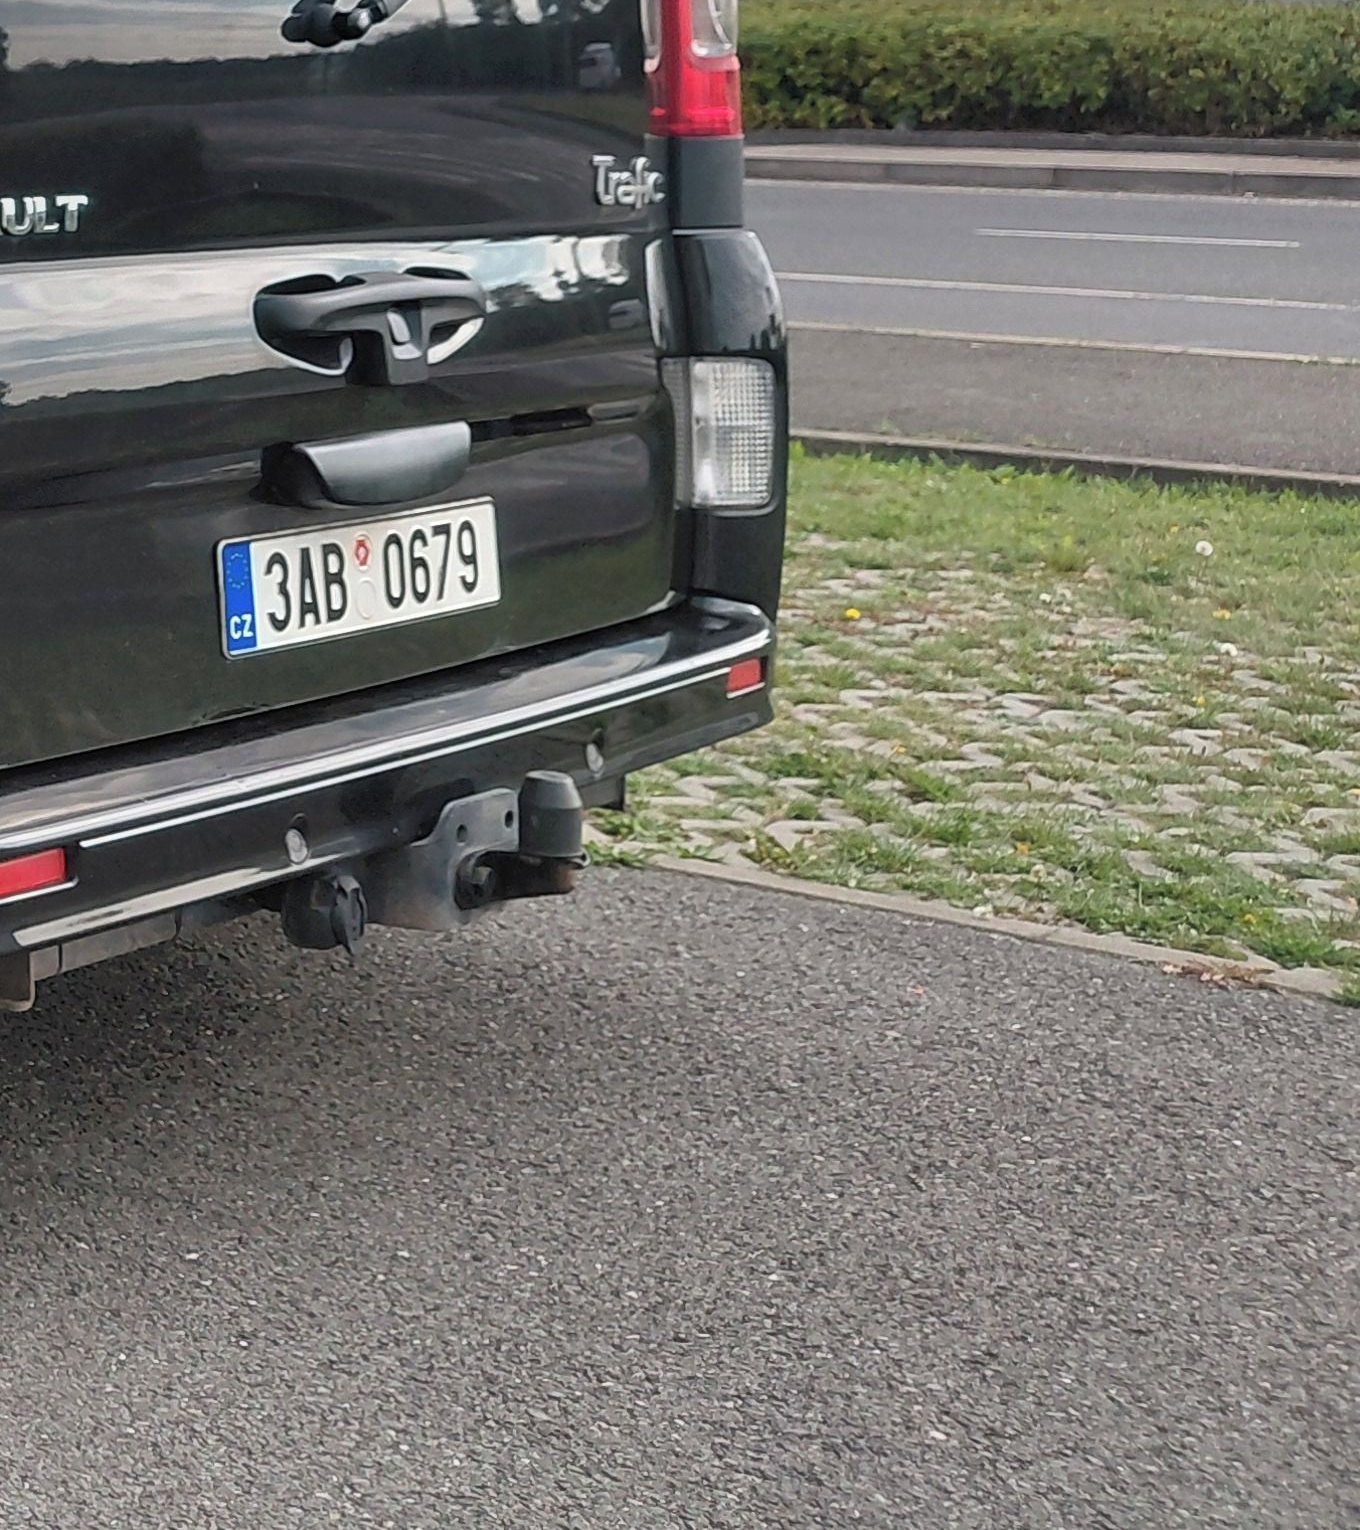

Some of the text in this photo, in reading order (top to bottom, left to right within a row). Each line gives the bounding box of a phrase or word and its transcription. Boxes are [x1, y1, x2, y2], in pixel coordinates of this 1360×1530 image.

[592, 155, 666, 209] Trafic
[264, 519, 478, 633] 3AB 0679
[230, 613, 254, 639] CZ
